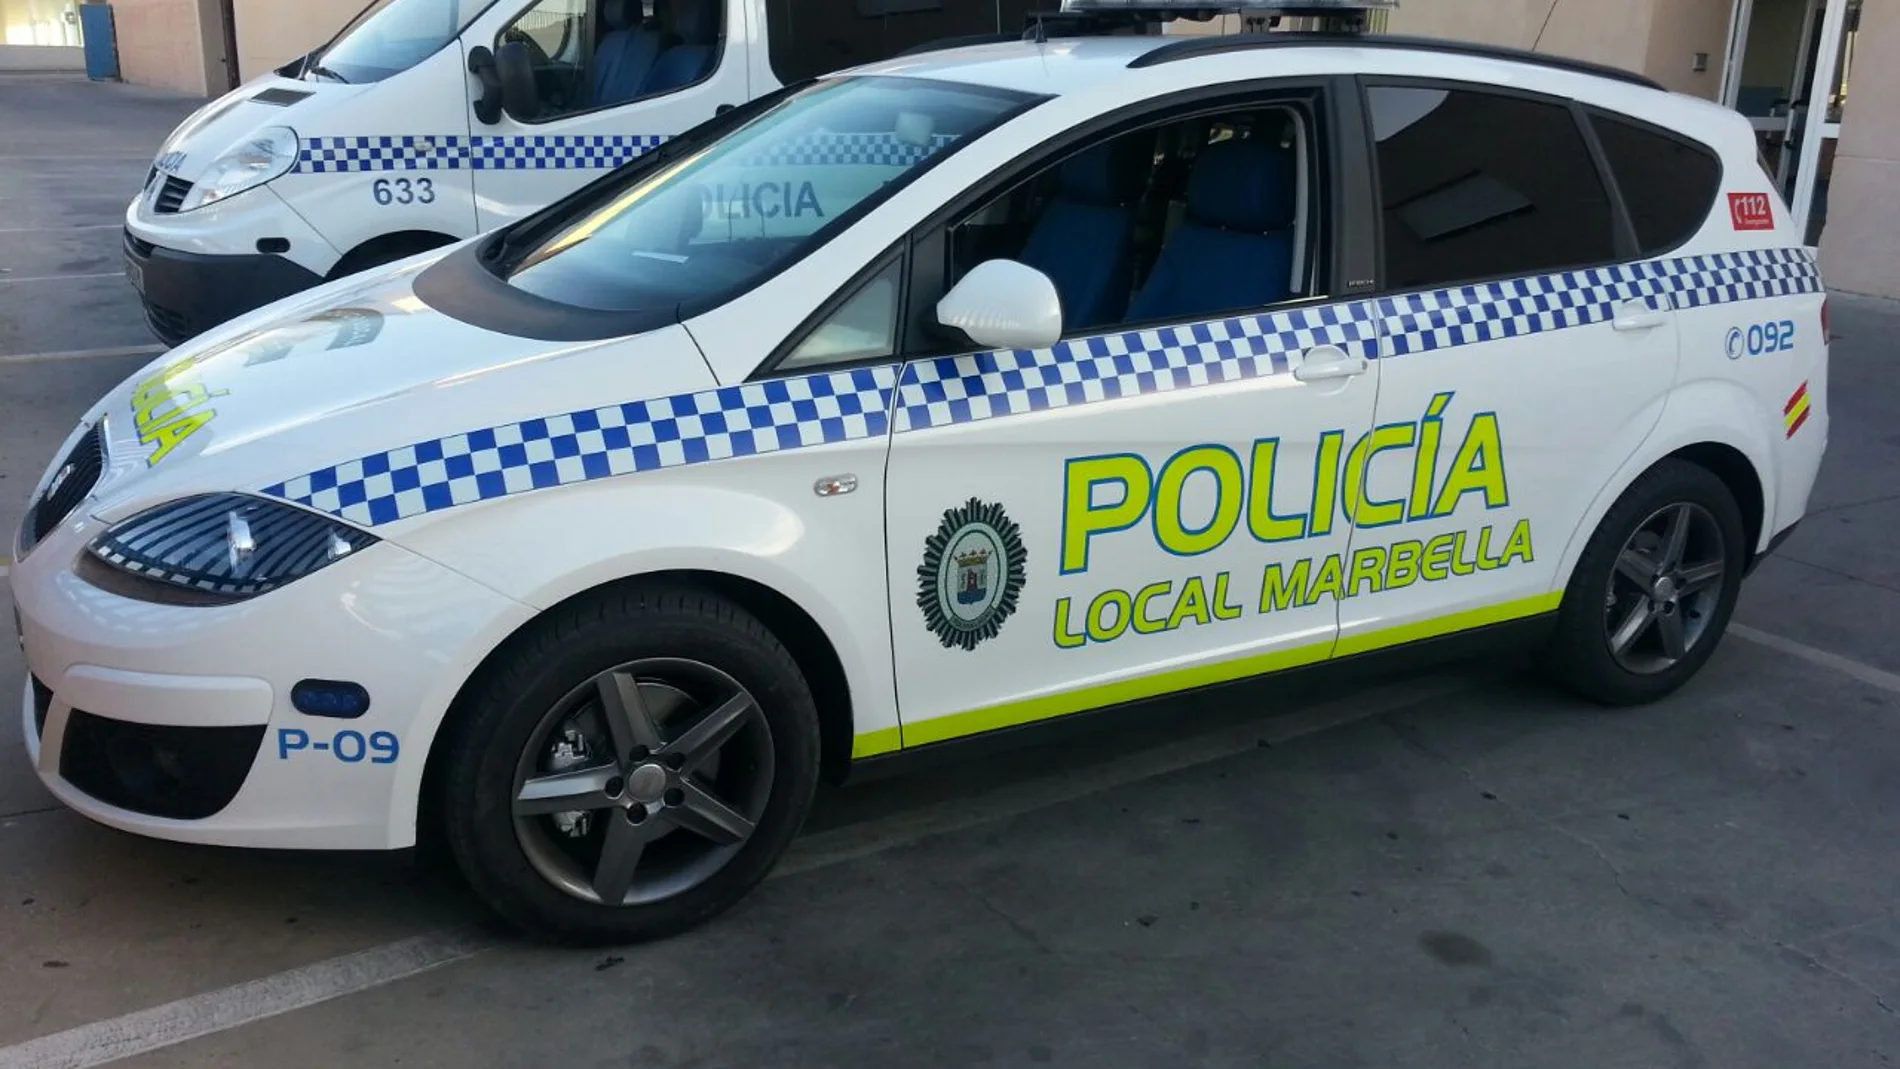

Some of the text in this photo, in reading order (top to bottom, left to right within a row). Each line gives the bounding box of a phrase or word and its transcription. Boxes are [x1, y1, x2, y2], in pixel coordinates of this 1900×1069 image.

[373, 177, 436, 206] 633
[1740, 195, 1767, 216] 112
[1747, 320, 1794, 356] 092
[1059, 391, 1509, 576] POLICÍA
[1053, 519, 1535, 649] LOCAL MARBELLA
[277, 728, 400, 764] P-09
